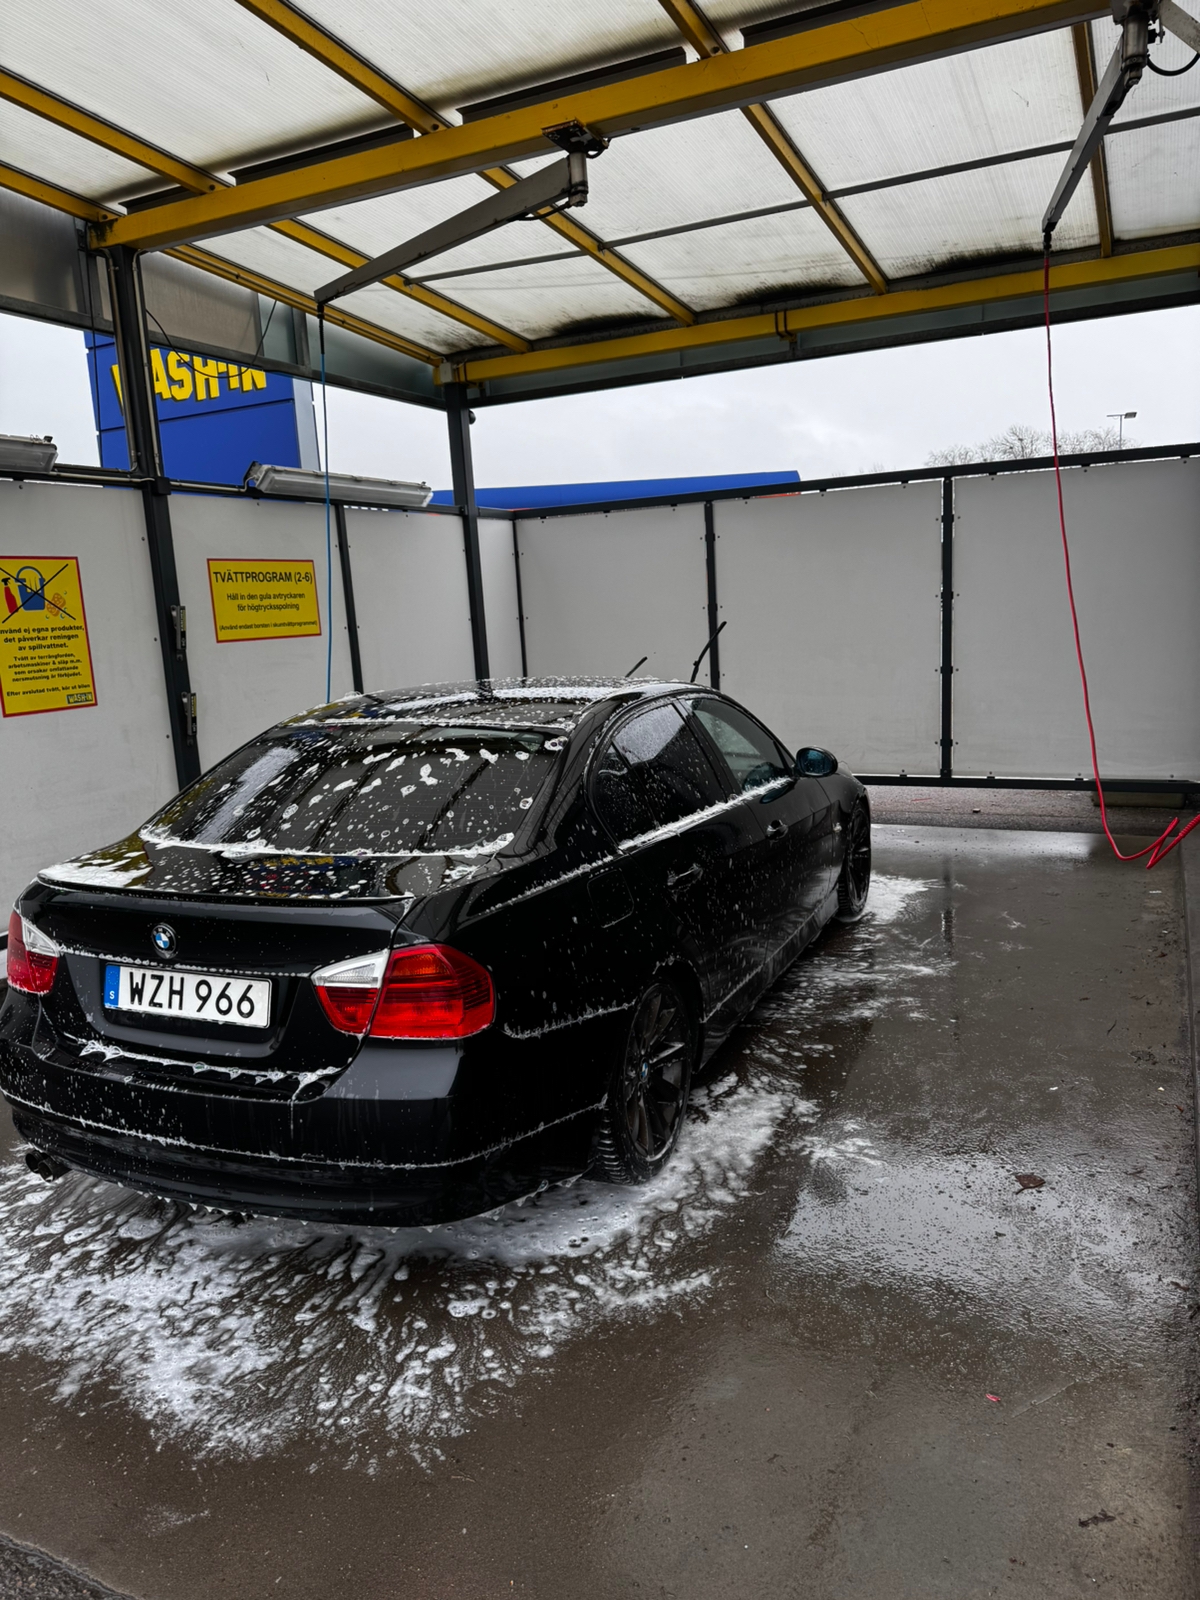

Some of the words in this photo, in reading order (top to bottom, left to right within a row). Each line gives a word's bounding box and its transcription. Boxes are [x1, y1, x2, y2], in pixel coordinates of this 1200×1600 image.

[213, 569, 293, 583] TVÄTTPROGRAM
[294, 572, 313, 585] (2-6)
[226, 593, 239, 601] Håll
[260, 592, 272, 602] gula
[273, 592, 306, 601] avtryckaren
[237, 603, 246, 612] för
[247, 602, 300, 612] högtrycksspolning
[4, 636, 16, 644] det
[18, 635, 48, 644] påverkar
[28, 642, 69, 651] spillvattnet.
[8, 661, 51, 669] arbetsmaskiner
[22, 687, 45, 695] avslutad
[109, 991, 115, 999] S
[129, 971, 185, 1010] WZH
[195, 979, 255, 1019] 966
